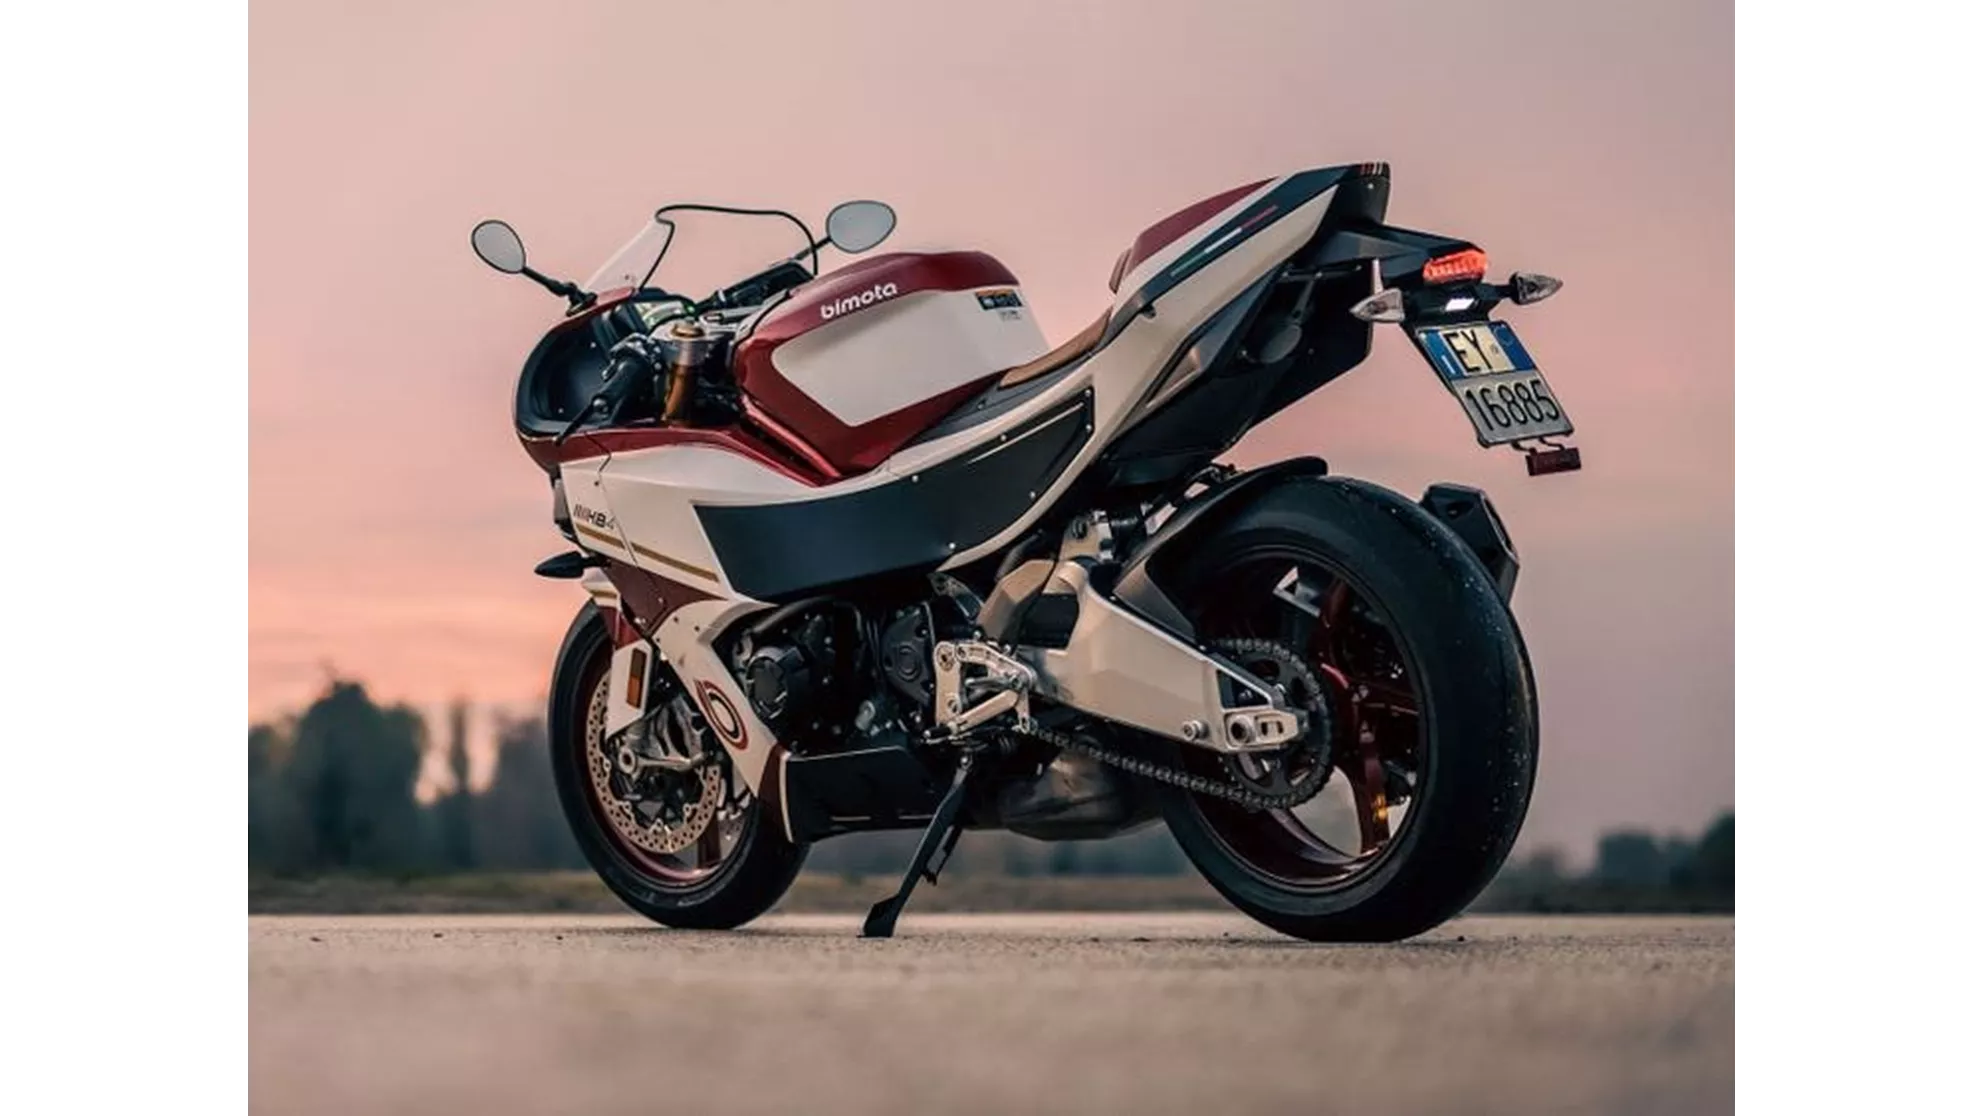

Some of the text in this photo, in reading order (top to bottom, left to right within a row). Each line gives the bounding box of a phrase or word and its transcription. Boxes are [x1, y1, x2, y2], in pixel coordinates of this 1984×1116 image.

[821, 282, 898, 319] bimota
[1443, 329, 1493, 373] EY
[1464, 379, 1560, 431] 16885
